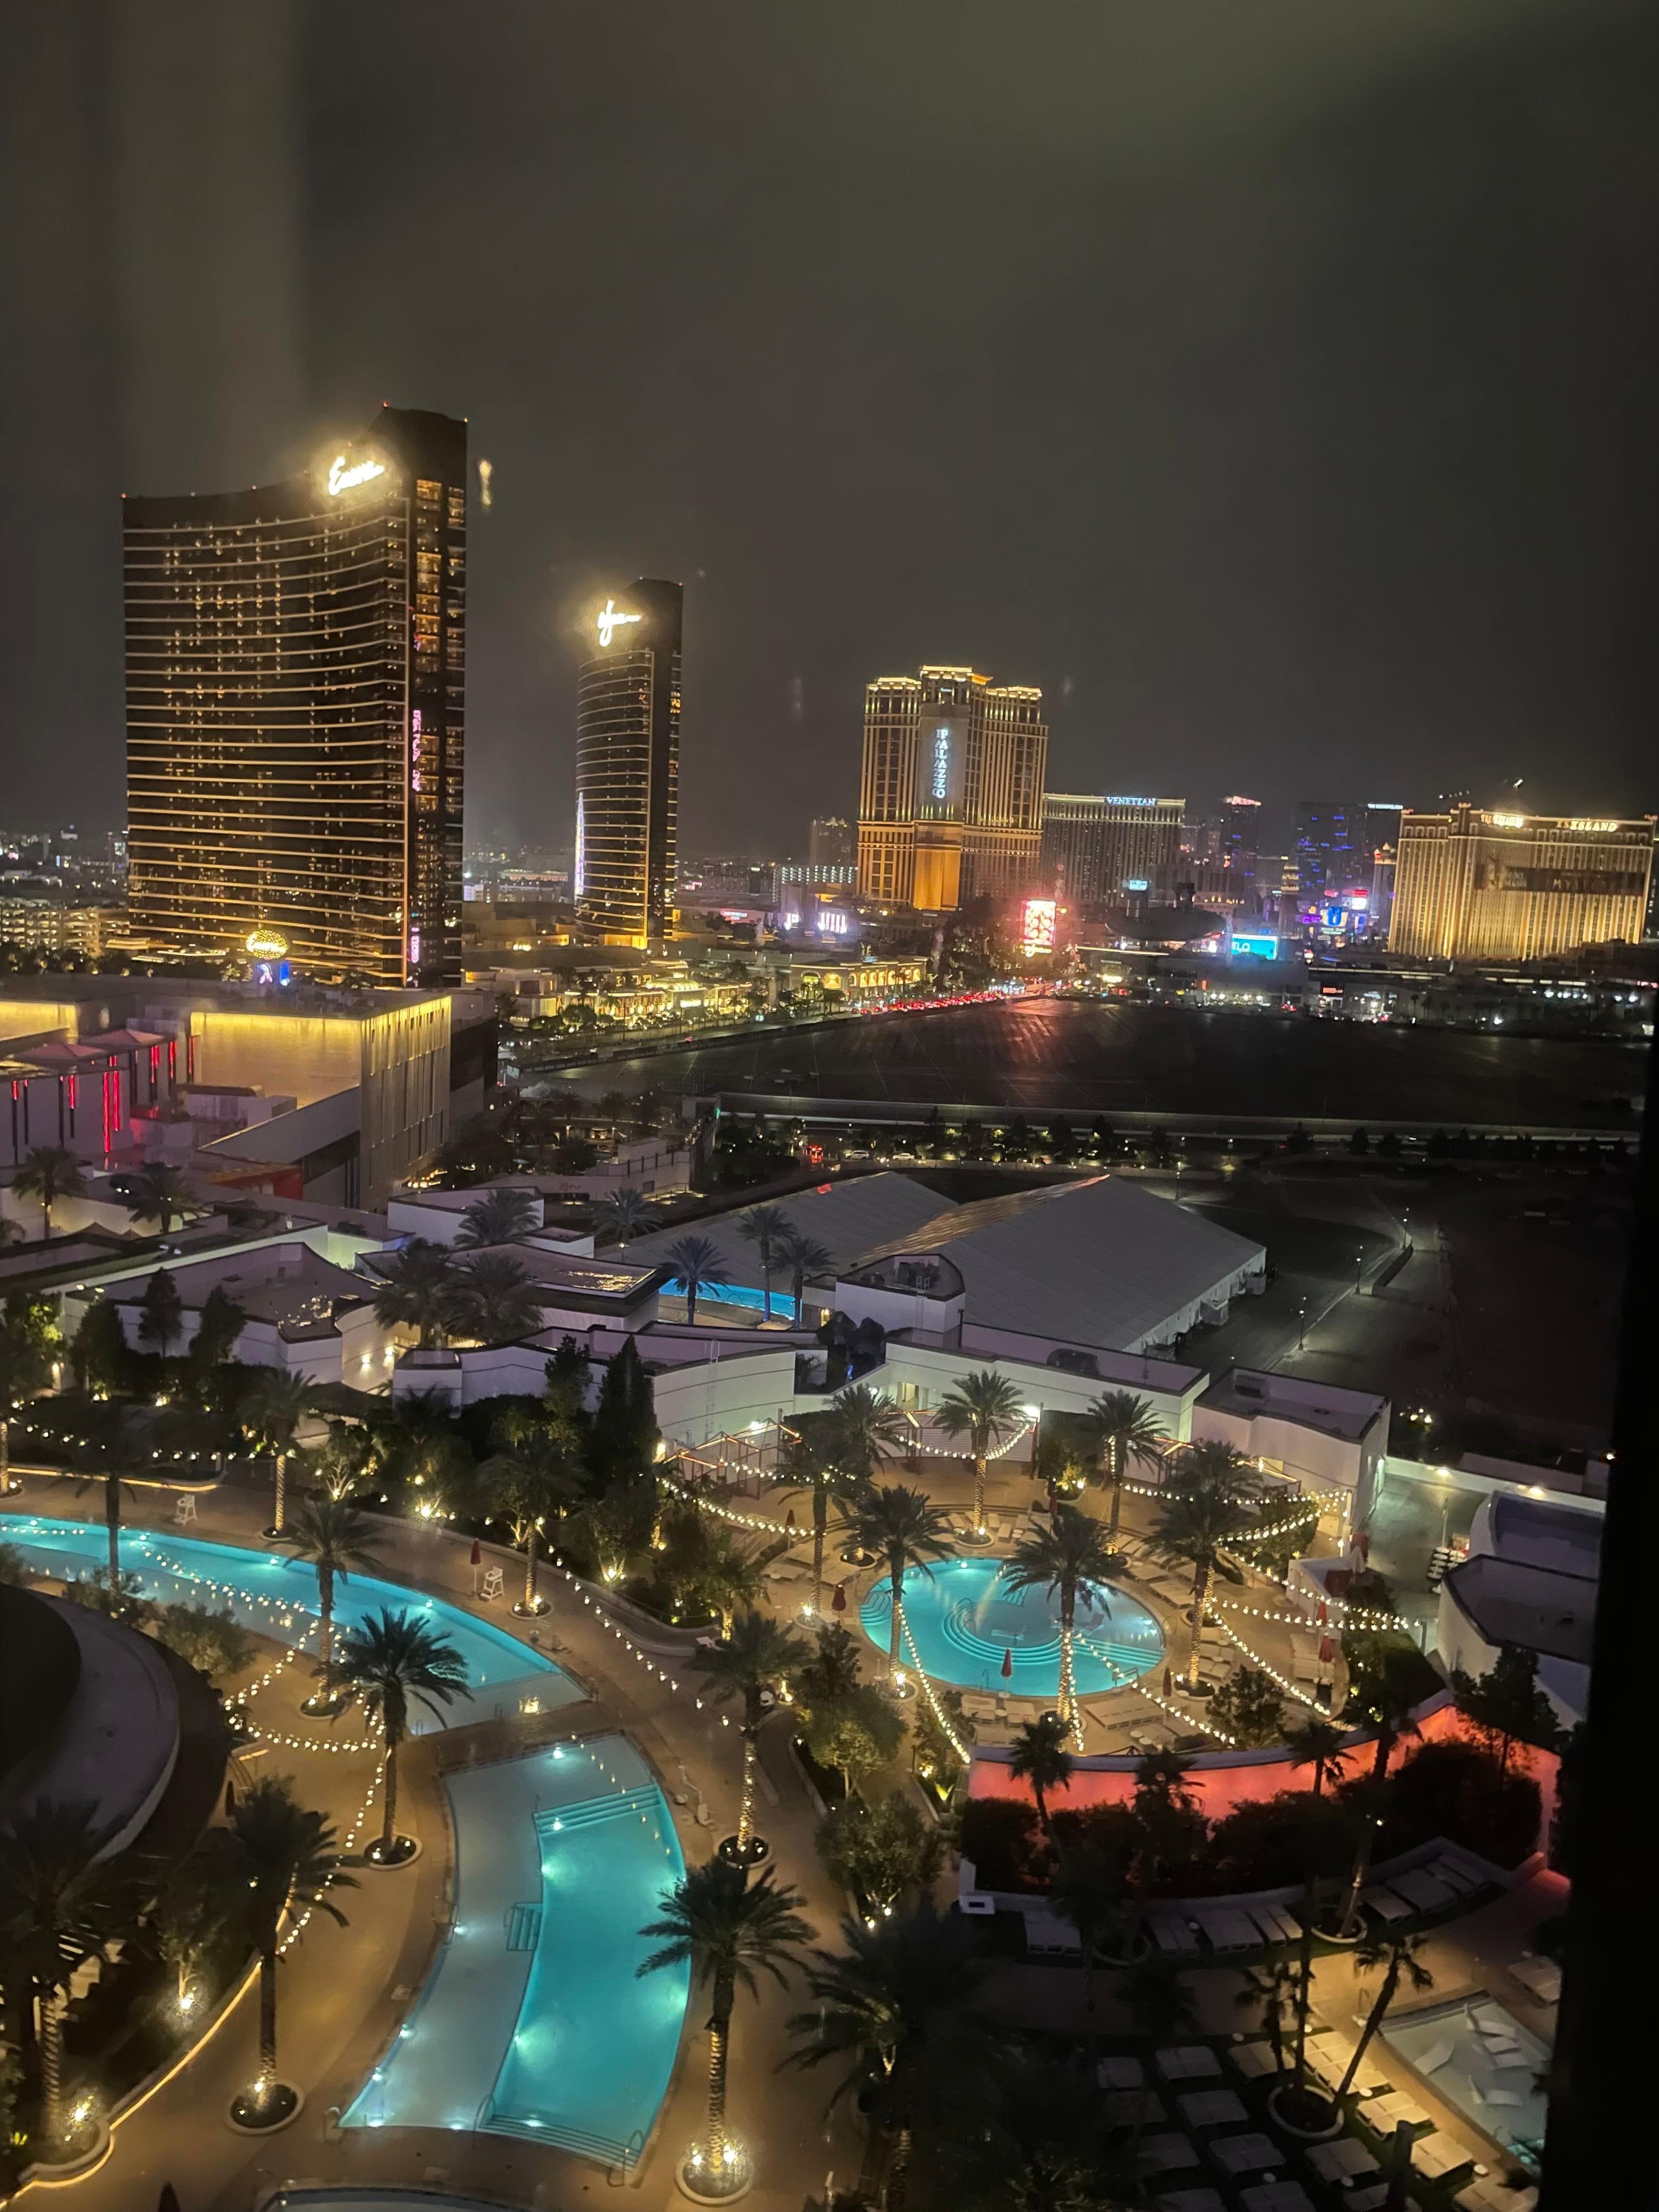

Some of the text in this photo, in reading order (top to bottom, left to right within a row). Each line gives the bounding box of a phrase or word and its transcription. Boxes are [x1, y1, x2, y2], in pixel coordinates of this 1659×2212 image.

[935, 728, 948, 799] PALAZZO
[1106, 796, 1156, 806] VENETIAN
[1570, 820, 1617, 832] ISLAND
